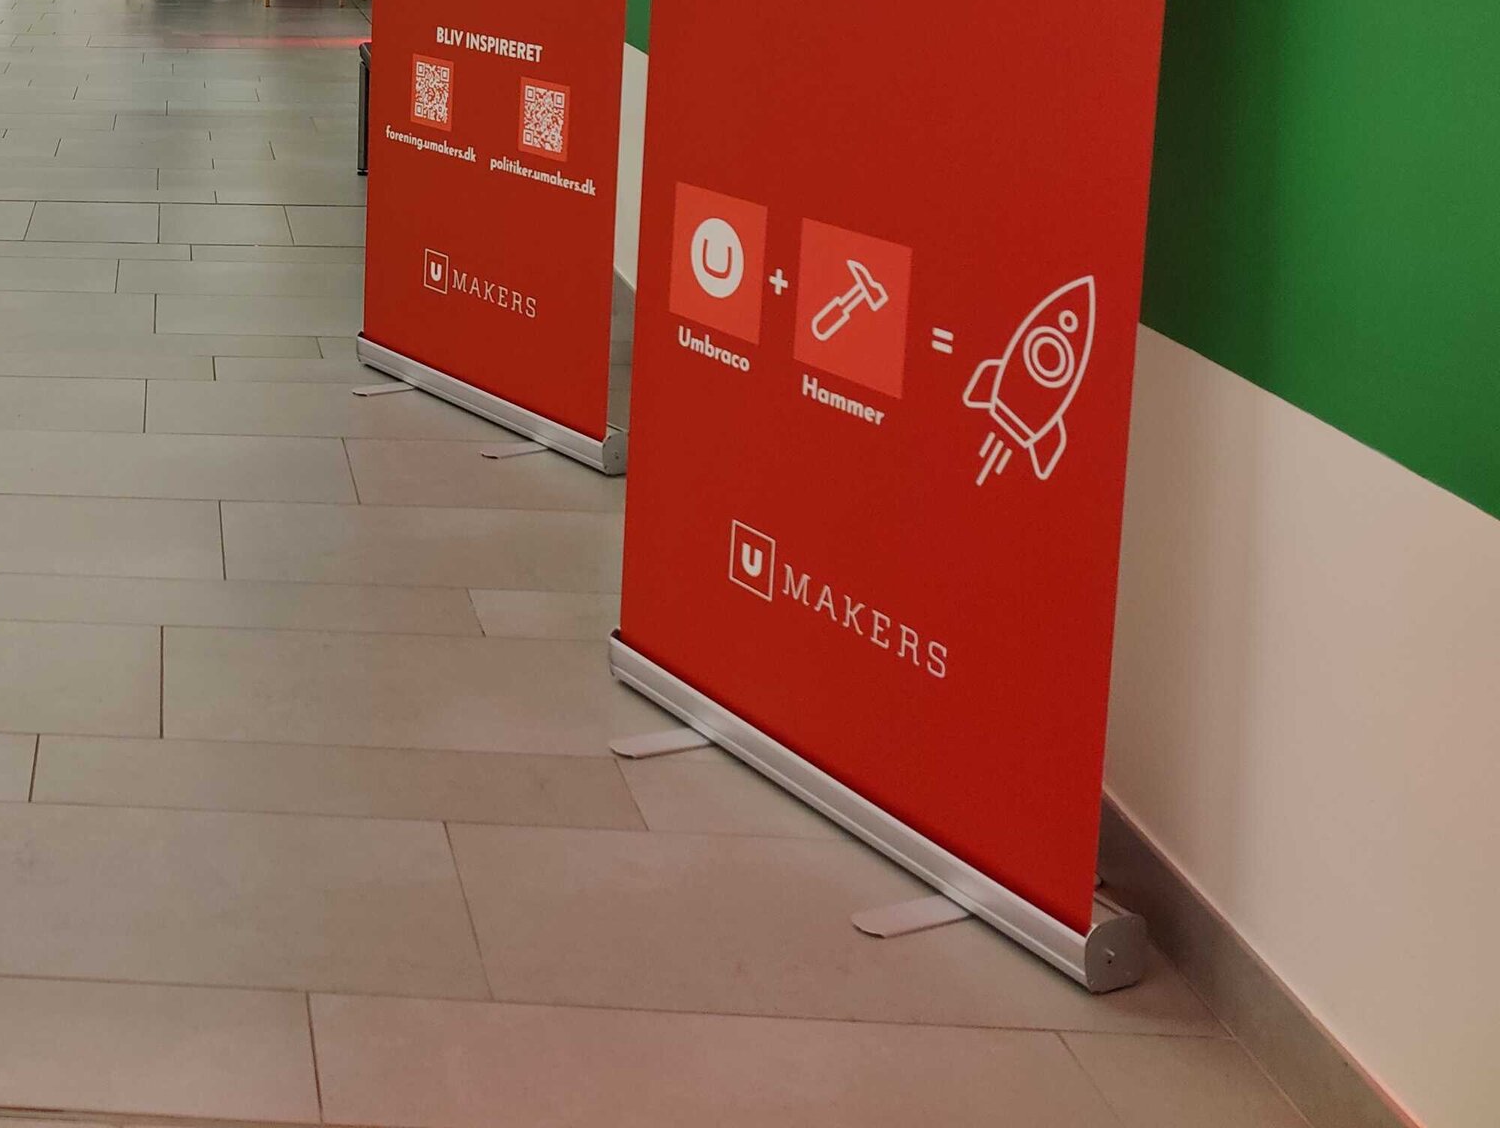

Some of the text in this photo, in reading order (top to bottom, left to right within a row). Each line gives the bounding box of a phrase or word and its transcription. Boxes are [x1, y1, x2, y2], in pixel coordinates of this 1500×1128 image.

[436, 26, 543, 63] BLIV INSPIRERET
[385, 124, 476, 162] forening.umakers.dk
[489, 156, 596, 196] politiker.umakers.dk
[451, 269, 537, 319] MAKERS
[677, 325, 750, 372] Umbraco
[801, 374, 885, 426] Hammer
[782, 563, 948, 679] MAKERS
